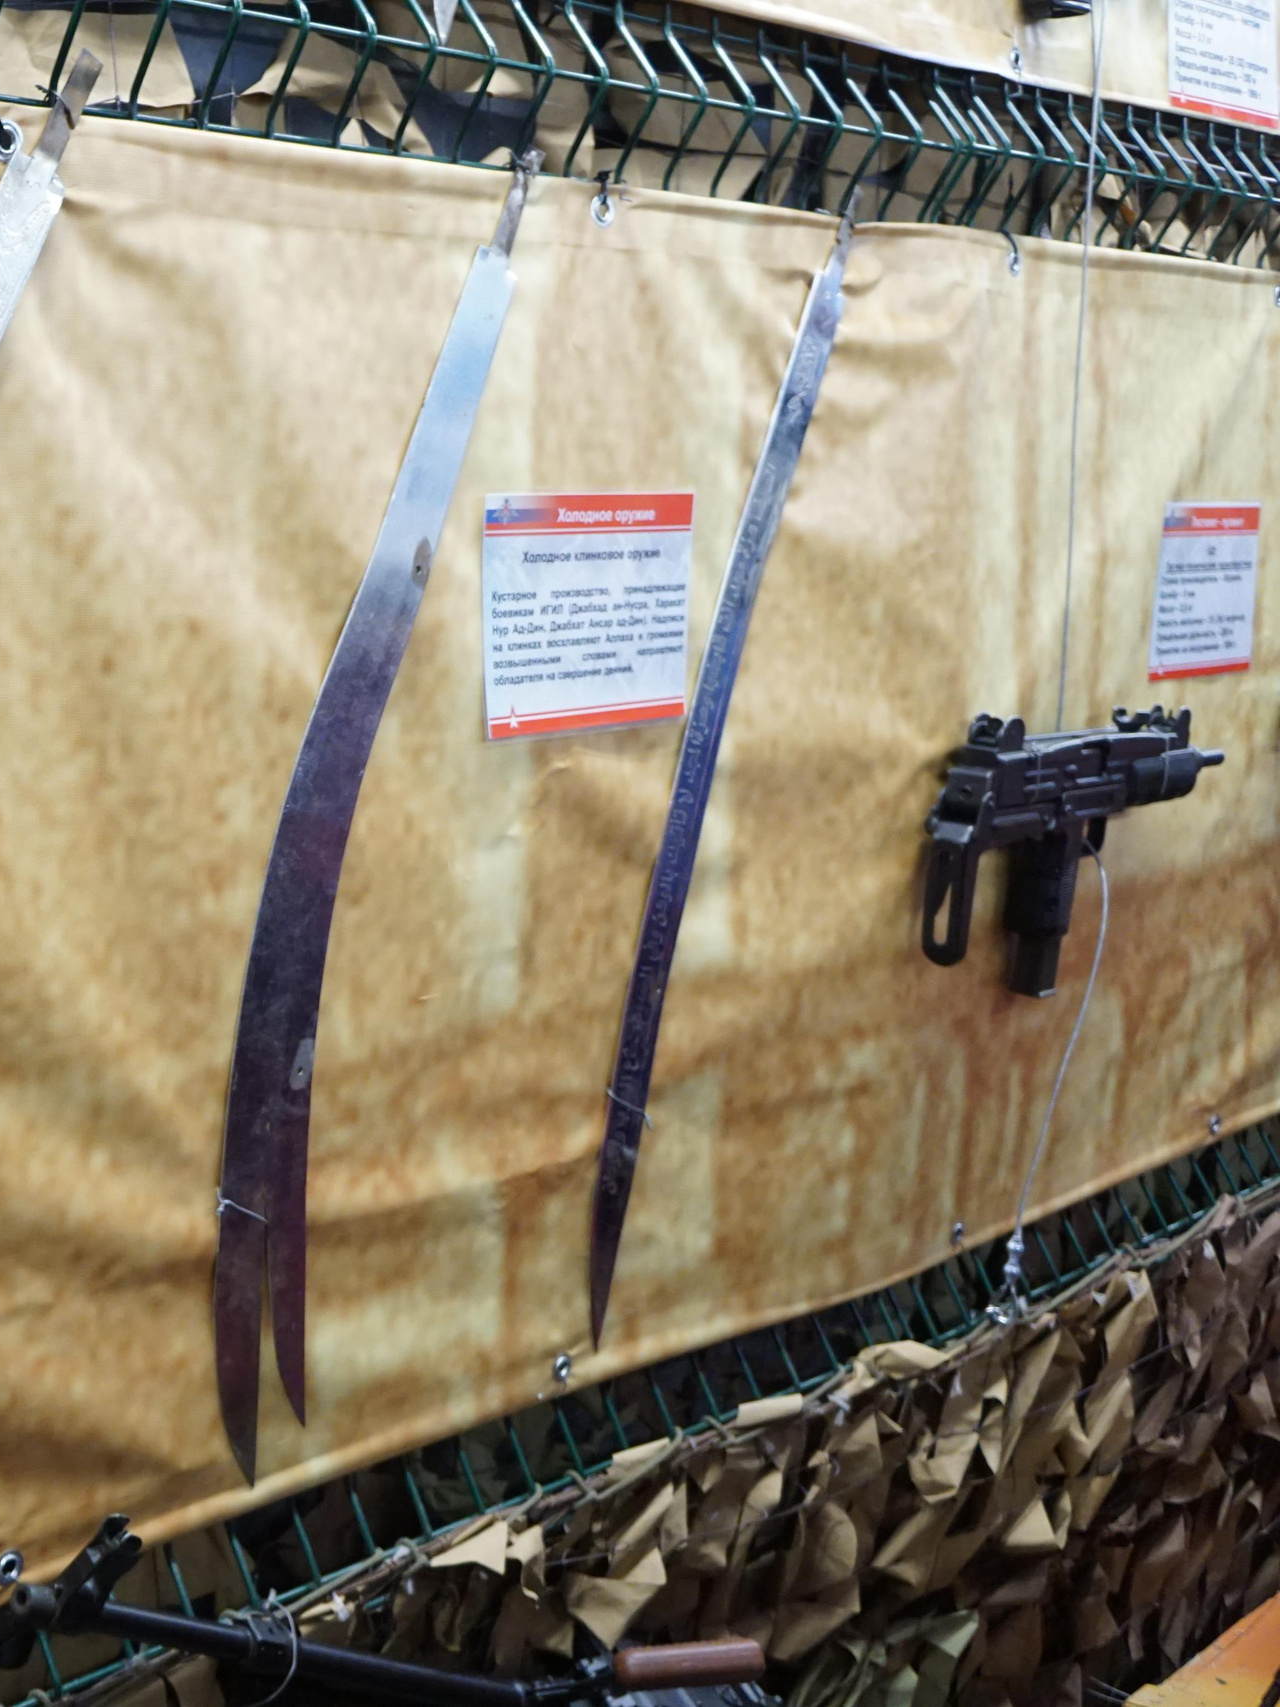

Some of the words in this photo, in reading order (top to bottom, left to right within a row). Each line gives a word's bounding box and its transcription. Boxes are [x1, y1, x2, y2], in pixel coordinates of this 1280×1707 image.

[557, 507, 613, 524] Холодное
[615, 509, 657, 525] оружие
[522, 551, 572, 564] Холодное
[574, 550, 624, 562] клинковое
[628, 549, 662, 562] оружие
[491, 591, 537, 604] Кустарное
[491, 607, 534, 619] боевикам
[540, 604, 564, 616] ИГИЛ
[492, 624, 509, 638] Нур
[492, 644, 503, 652] на
[508, 641, 542, 652] клинках
[493, 656, 562, 670] возвышенными
[582, 651, 617, 662] словами
[494, 673, 544, 686] обладателя
[546, 672, 556, 680] на
